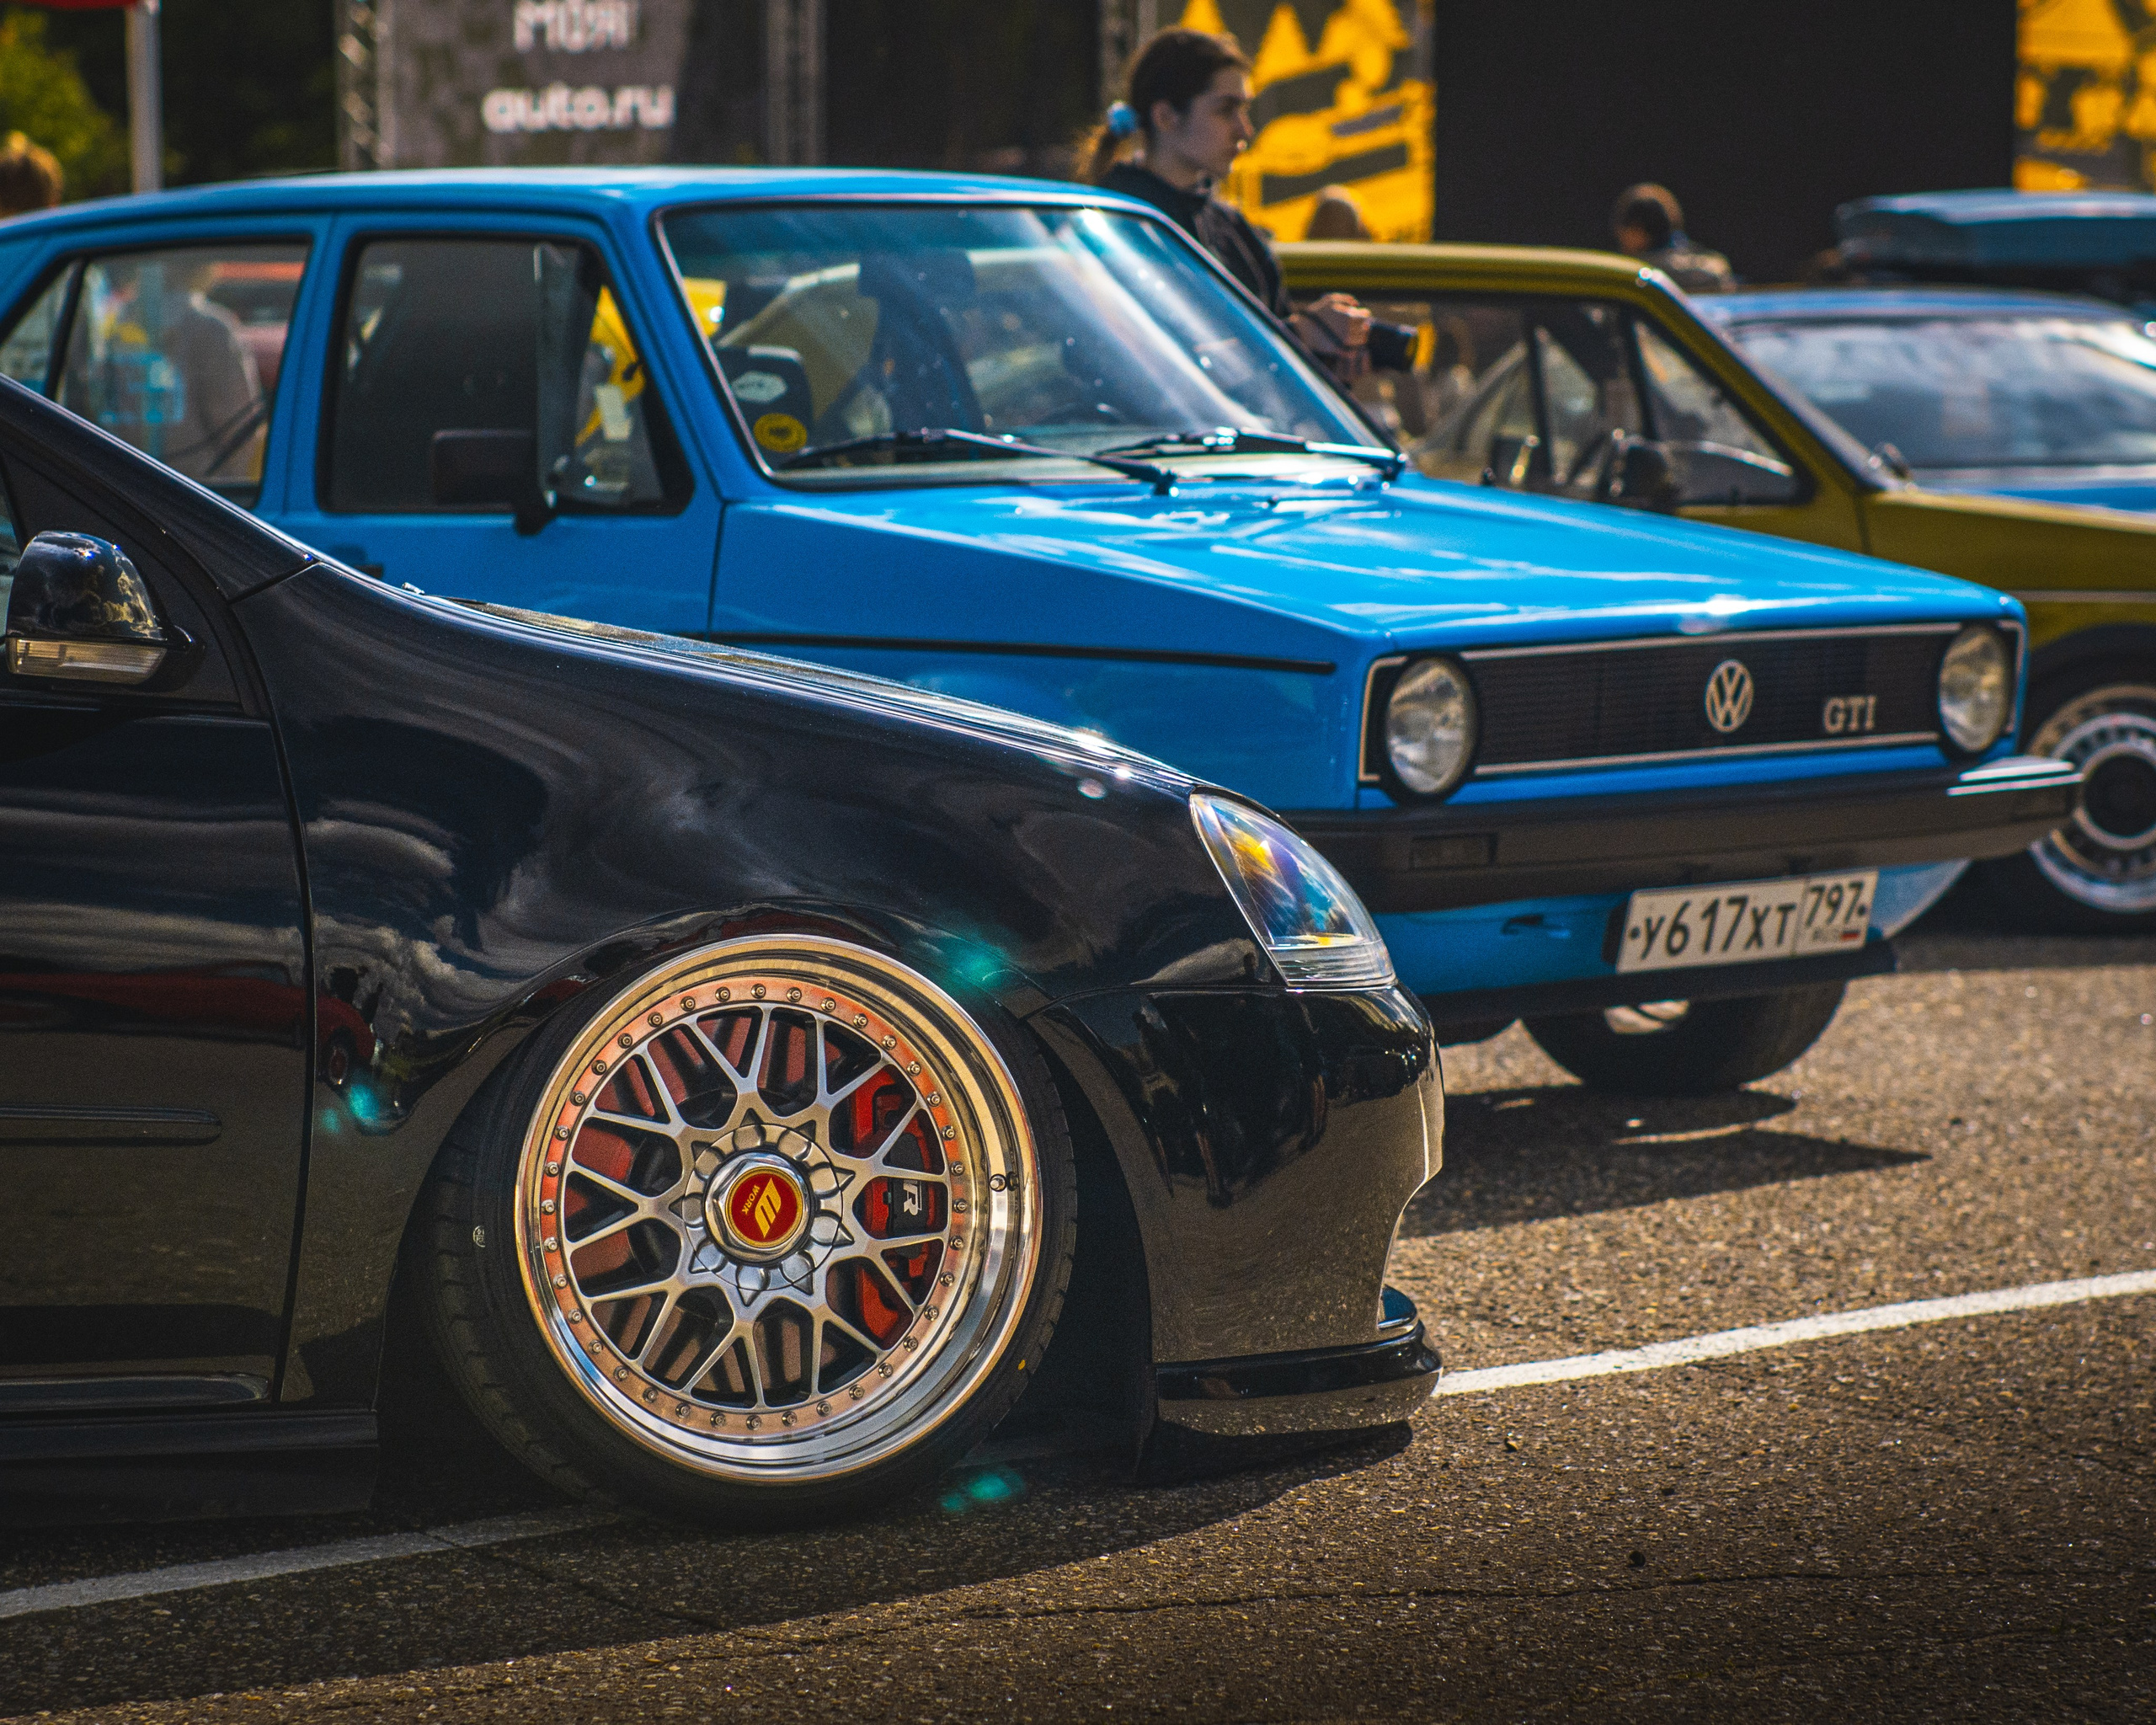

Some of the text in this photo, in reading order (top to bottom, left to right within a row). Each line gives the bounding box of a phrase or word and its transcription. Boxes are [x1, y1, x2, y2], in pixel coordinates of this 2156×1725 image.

[483, 83, 675, 131] auto.ru
[1822, 696, 1877, 734] GTI
[1805, 882, 1864, 927] 797
[741, 1184, 760, 1215] WORK
